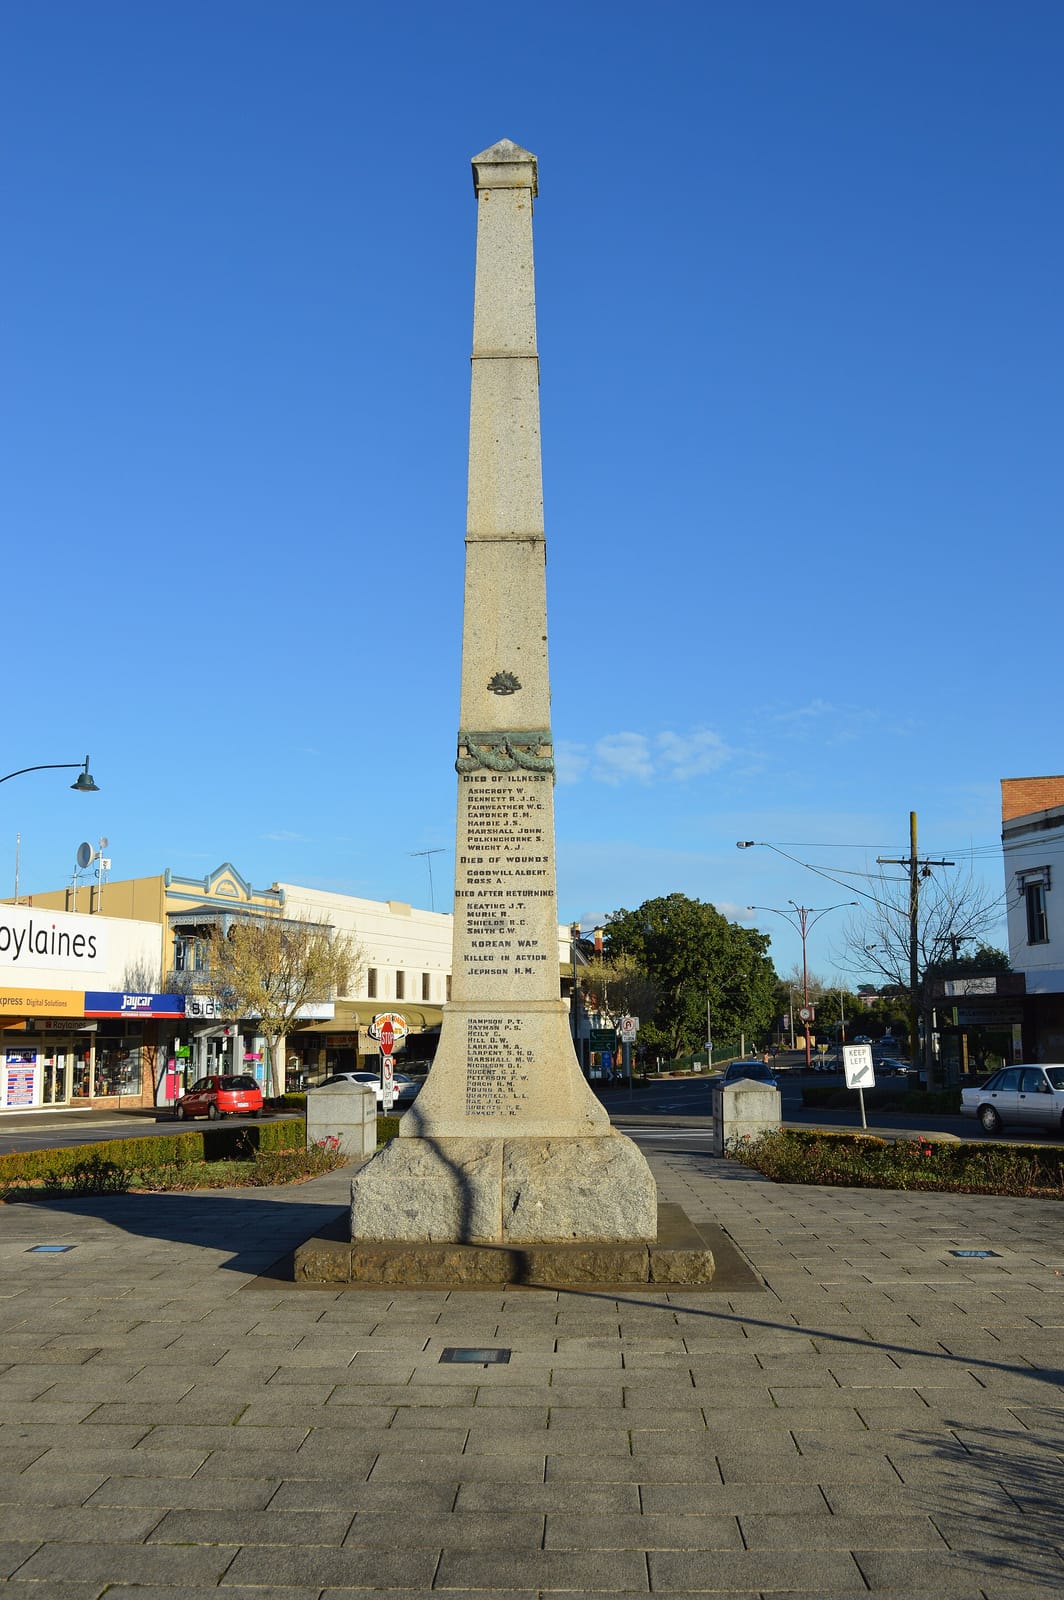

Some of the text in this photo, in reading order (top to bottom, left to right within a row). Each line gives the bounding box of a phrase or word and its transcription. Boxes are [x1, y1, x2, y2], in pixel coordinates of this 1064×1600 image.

[44, 999, 68, 1007] Solutions
[381, 1031, 394, 1045] STOP
[849, 1049, 866, 1057] KEEP
[850, 1057, 866, 1065] LEFT
